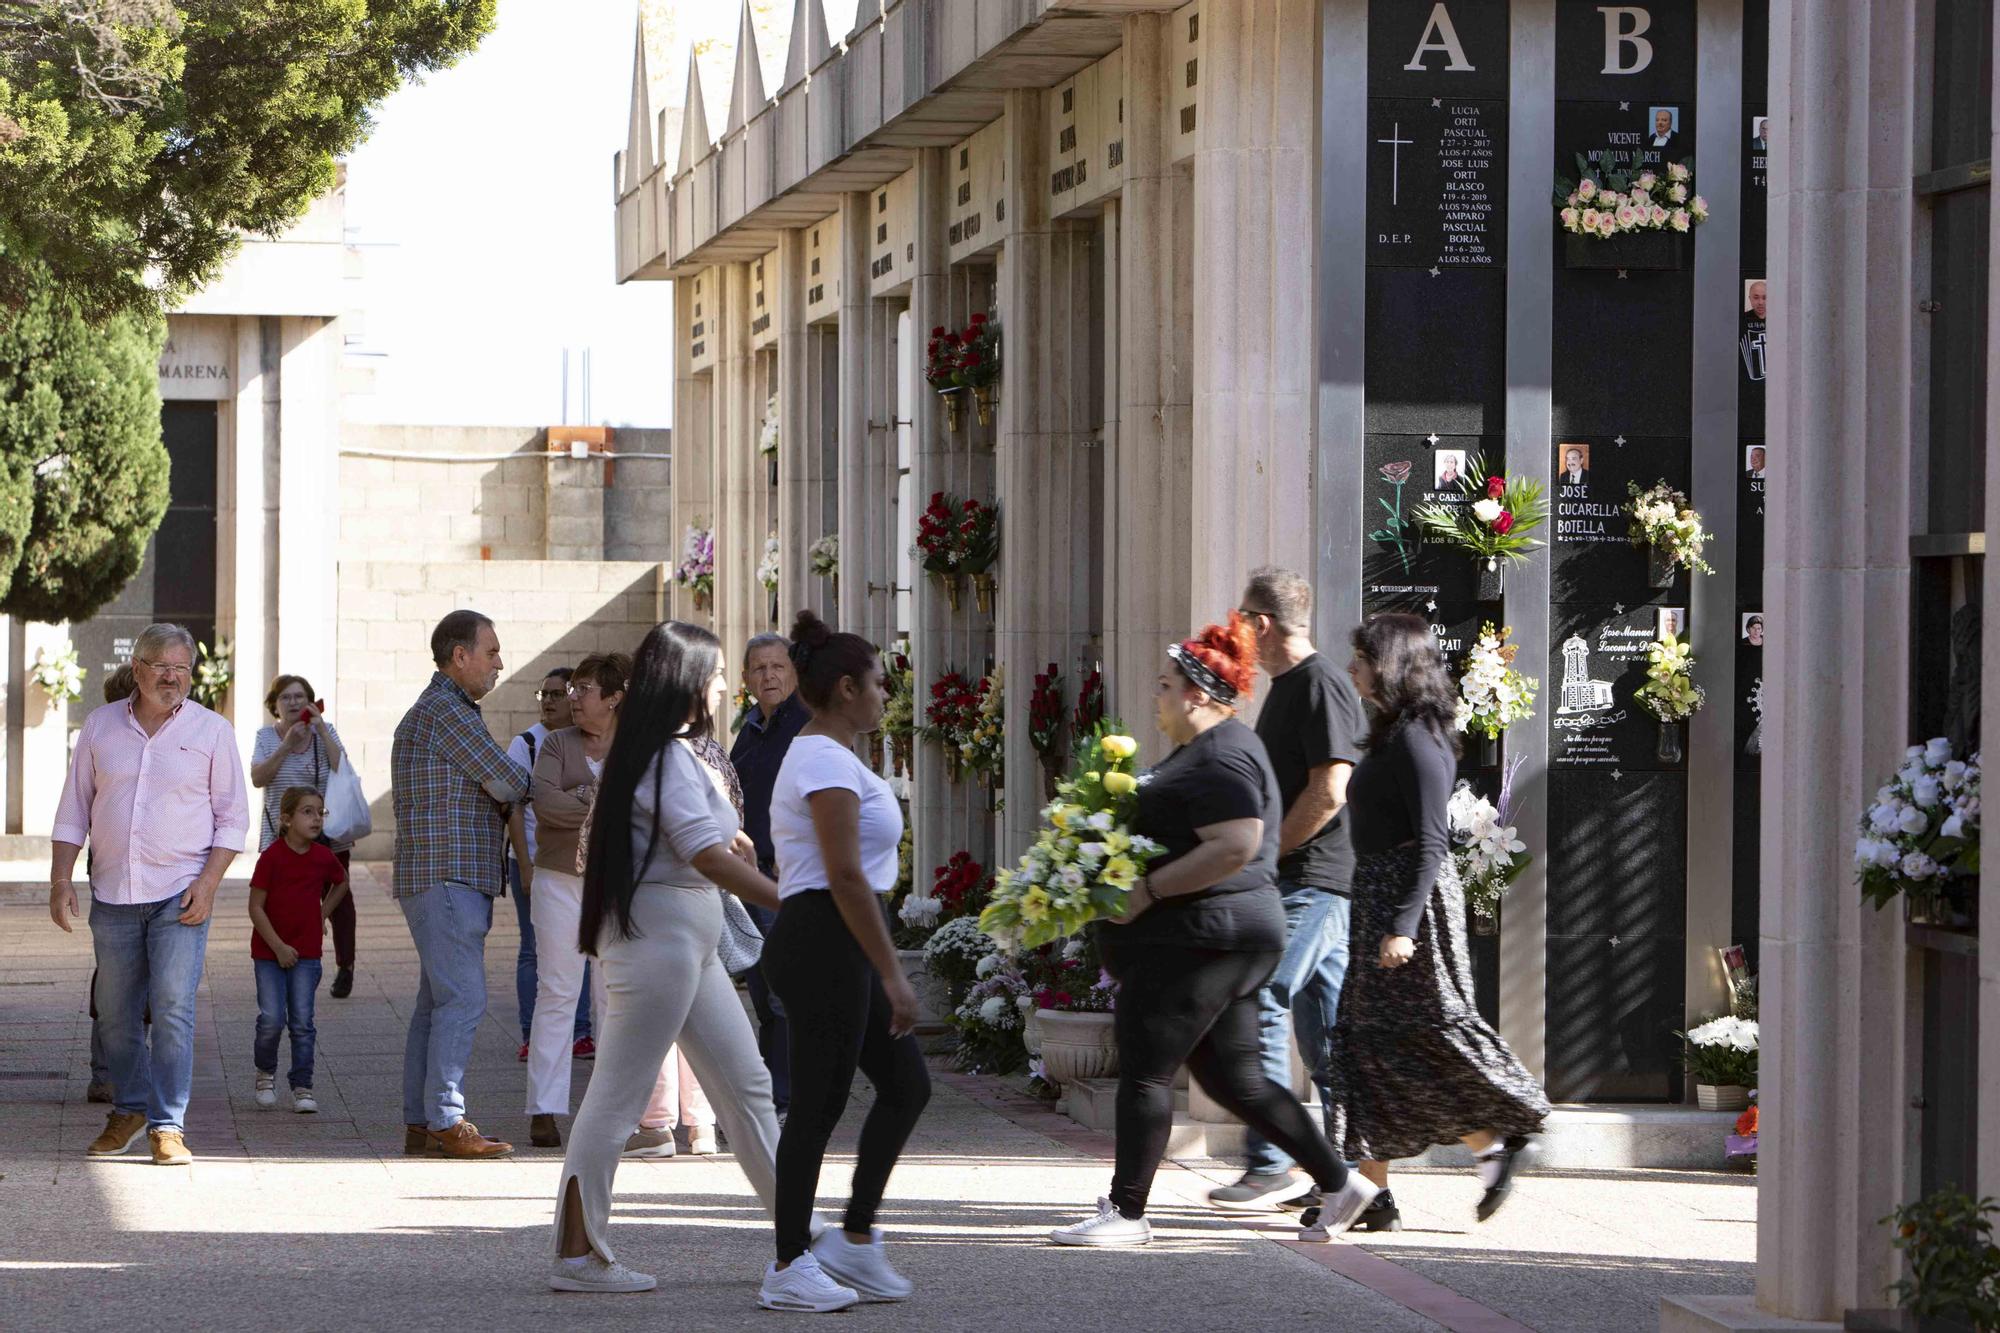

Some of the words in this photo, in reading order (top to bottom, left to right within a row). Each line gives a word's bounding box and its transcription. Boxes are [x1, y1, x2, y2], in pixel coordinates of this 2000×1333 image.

[1404, 3, 1475, 71] A
[1597, 7, 1653, 74] B
[1452, 106, 1480, 115] LUCIA
[1454, 118, 1476, 126] ORTI
[1444, 129, 1487, 137] PASCUAL
[1608, 132, 1640, 144] VICENTE
[1471, 148, 1493, 157] AÑOS
[1468, 160, 1489, 168] LUIS
[1454, 171, 1476, 179] ORTI
[1446, 182, 1485, 190] BLASCO
[1471, 202, 1492, 211] AÑOS
[1443, 224, 1487, 232] PASCUAL
[1471, 254, 1492, 263] AÑOS
[1559, 502, 1620, 517] CUCARELLA
[1558, 520, 1605, 534] BOTELLA
[1621, 625, 1656, 637] Manuel
[1598, 641, 1637, 652] Lacomba
